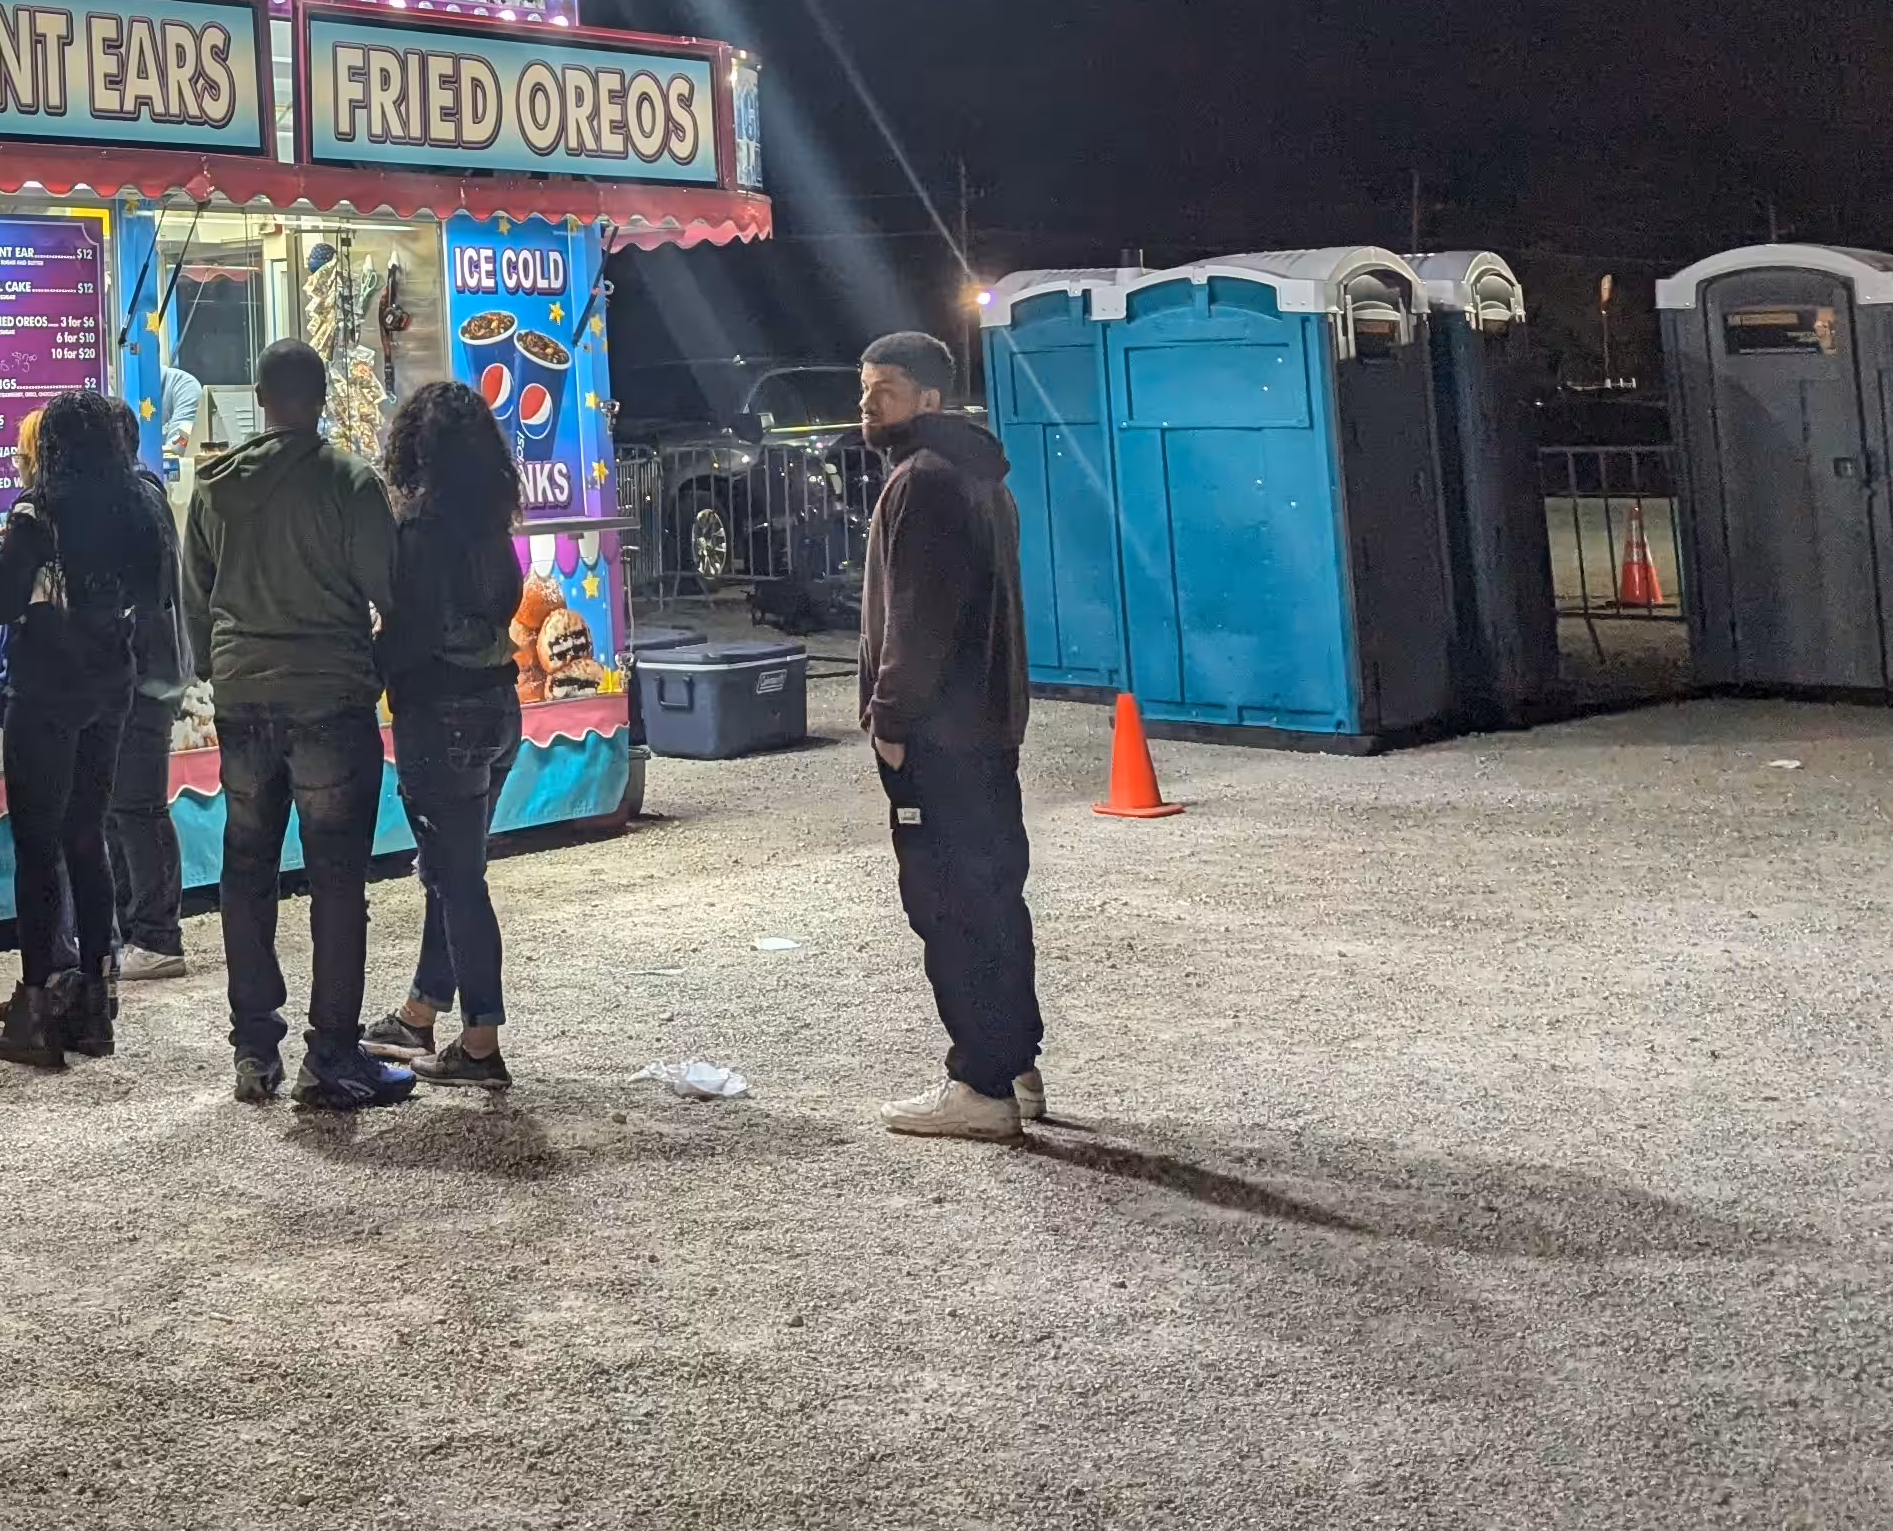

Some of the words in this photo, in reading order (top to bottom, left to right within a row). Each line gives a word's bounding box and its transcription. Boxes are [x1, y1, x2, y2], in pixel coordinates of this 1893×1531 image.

[87, 10, 235, 129] EARS
[331, 40, 500, 151] FRIED
[514, 59, 700, 166] OREOS
[15, 246, 35, 258] EAR
[76, 248, 93, 261] $12
[454, 246, 498, 295] ICE
[501, 247, 568, 296] COLD
[5, 281, 32, 293] CAKE
[77, 282, 94, 294] $12
[15, 316, 48, 328] OREOS
[60, 316, 67, 328] 3
[68, 316, 82, 328] for
[83, 316, 95, 328] $6
[56, 332, 63, 343] 6
[64, 332, 78, 343] for
[79, 332, 96, 344] $10
[51, 348, 63, 359] 10
[64, 348, 78, 359] for
[78, 348, 96, 360] $20
[84, 377, 97, 389] $2
[518, 459, 572, 509] NKS
